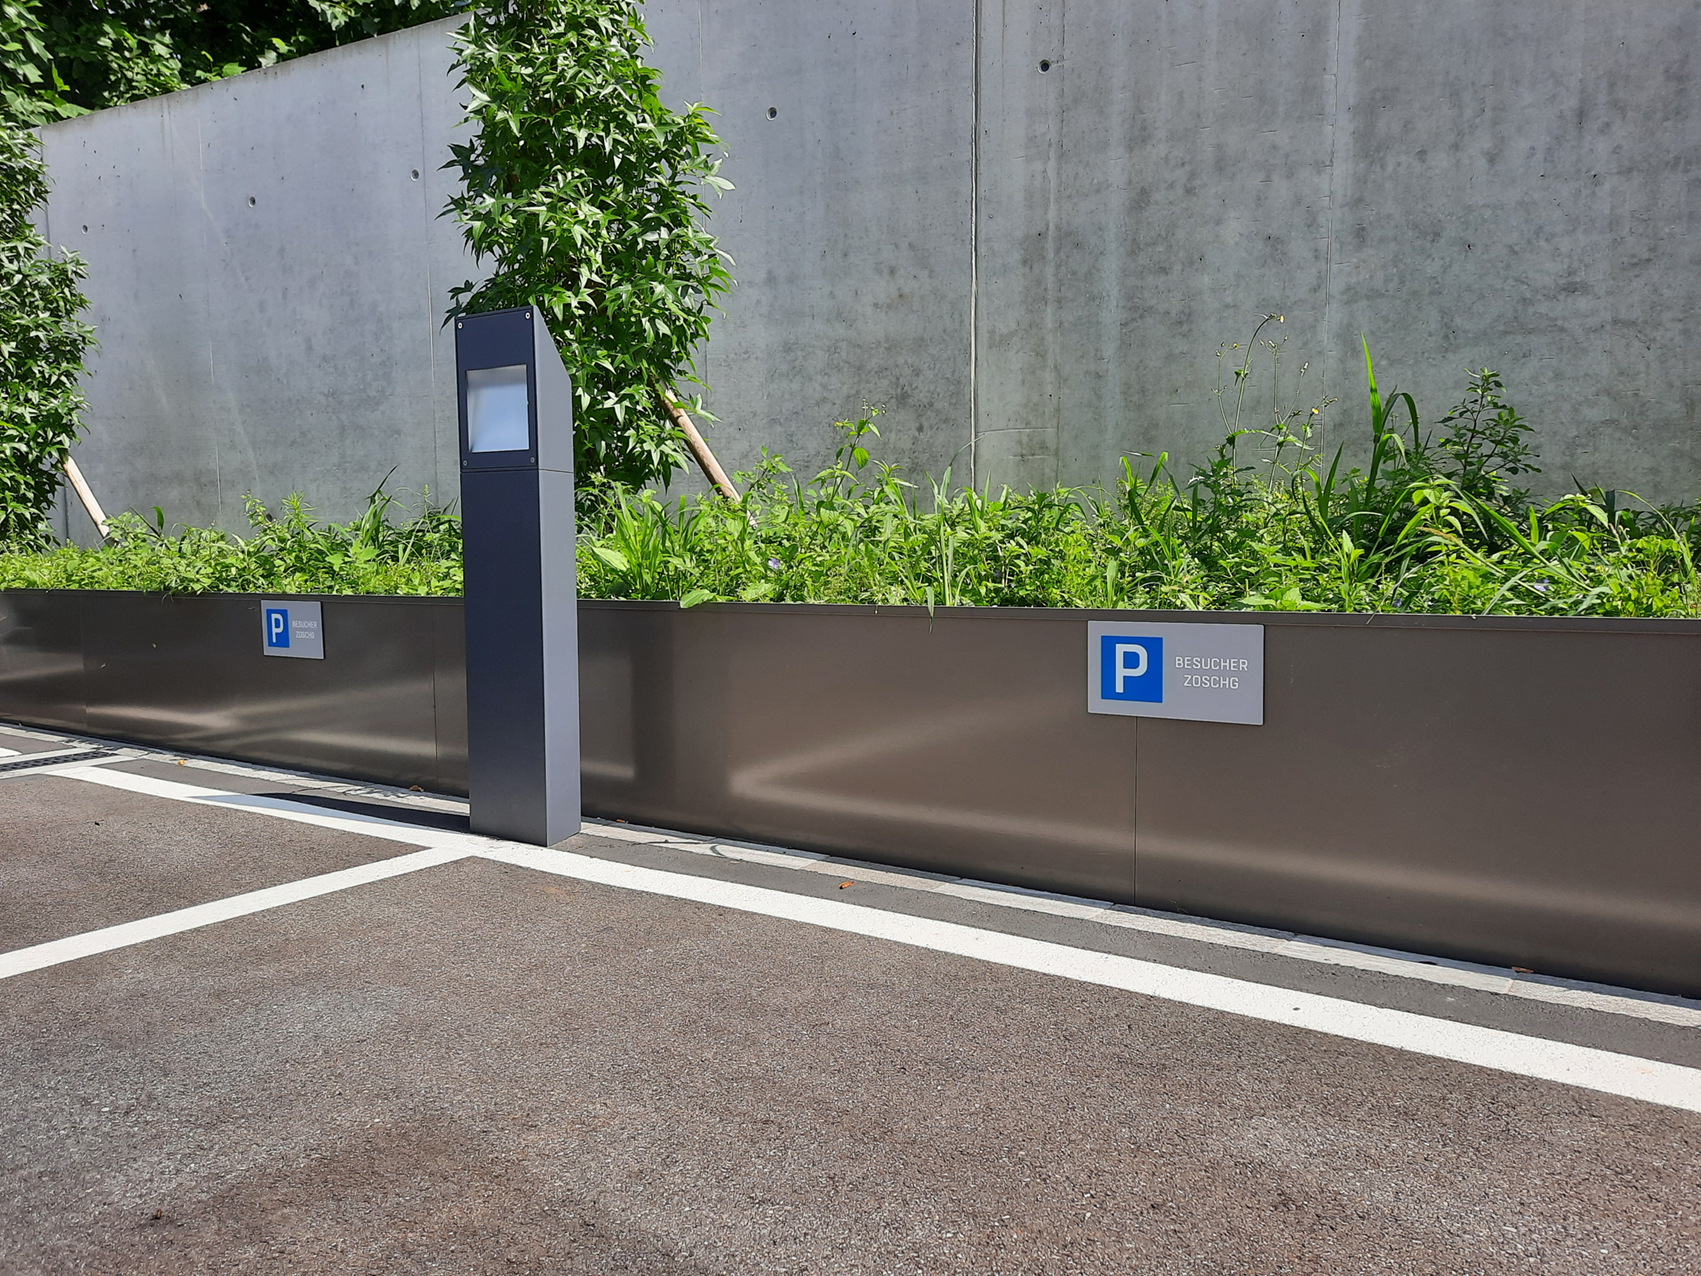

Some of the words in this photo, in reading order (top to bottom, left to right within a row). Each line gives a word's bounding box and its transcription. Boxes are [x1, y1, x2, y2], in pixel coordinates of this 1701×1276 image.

[271, 613, 284, 643] P
[1115, 643, 1148, 693] P
[1175, 656, 1248, 672] BESUCHER
[1183, 674, 1239, 690] ZOSCHG
